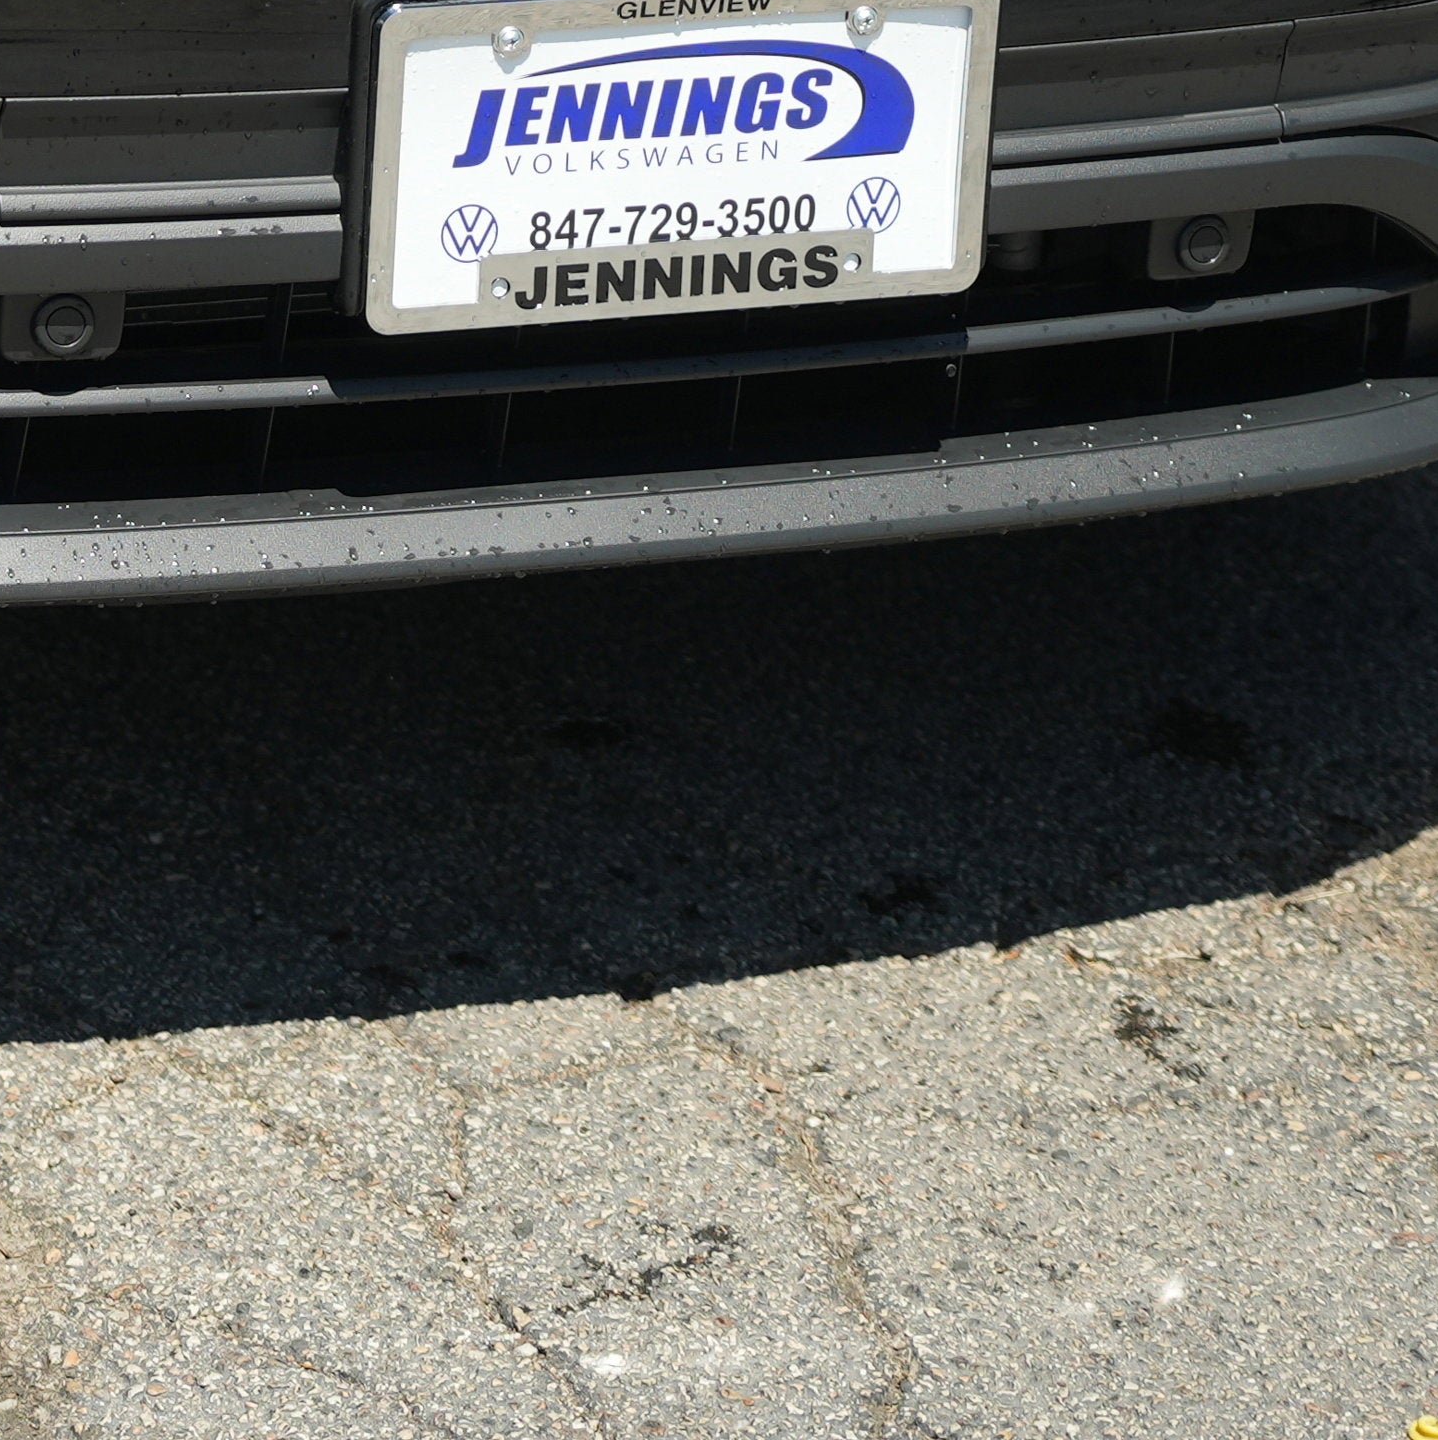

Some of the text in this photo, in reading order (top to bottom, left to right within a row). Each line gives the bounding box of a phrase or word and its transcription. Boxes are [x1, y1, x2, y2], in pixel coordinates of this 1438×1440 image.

[452, 68, 833, 169] JENNINGS
[505, 140, 779, 176] VOLKSWAGEN
[529, 193, 816, 251] 847-729-3500
[514, 245, 839, 310] JENNINGS
